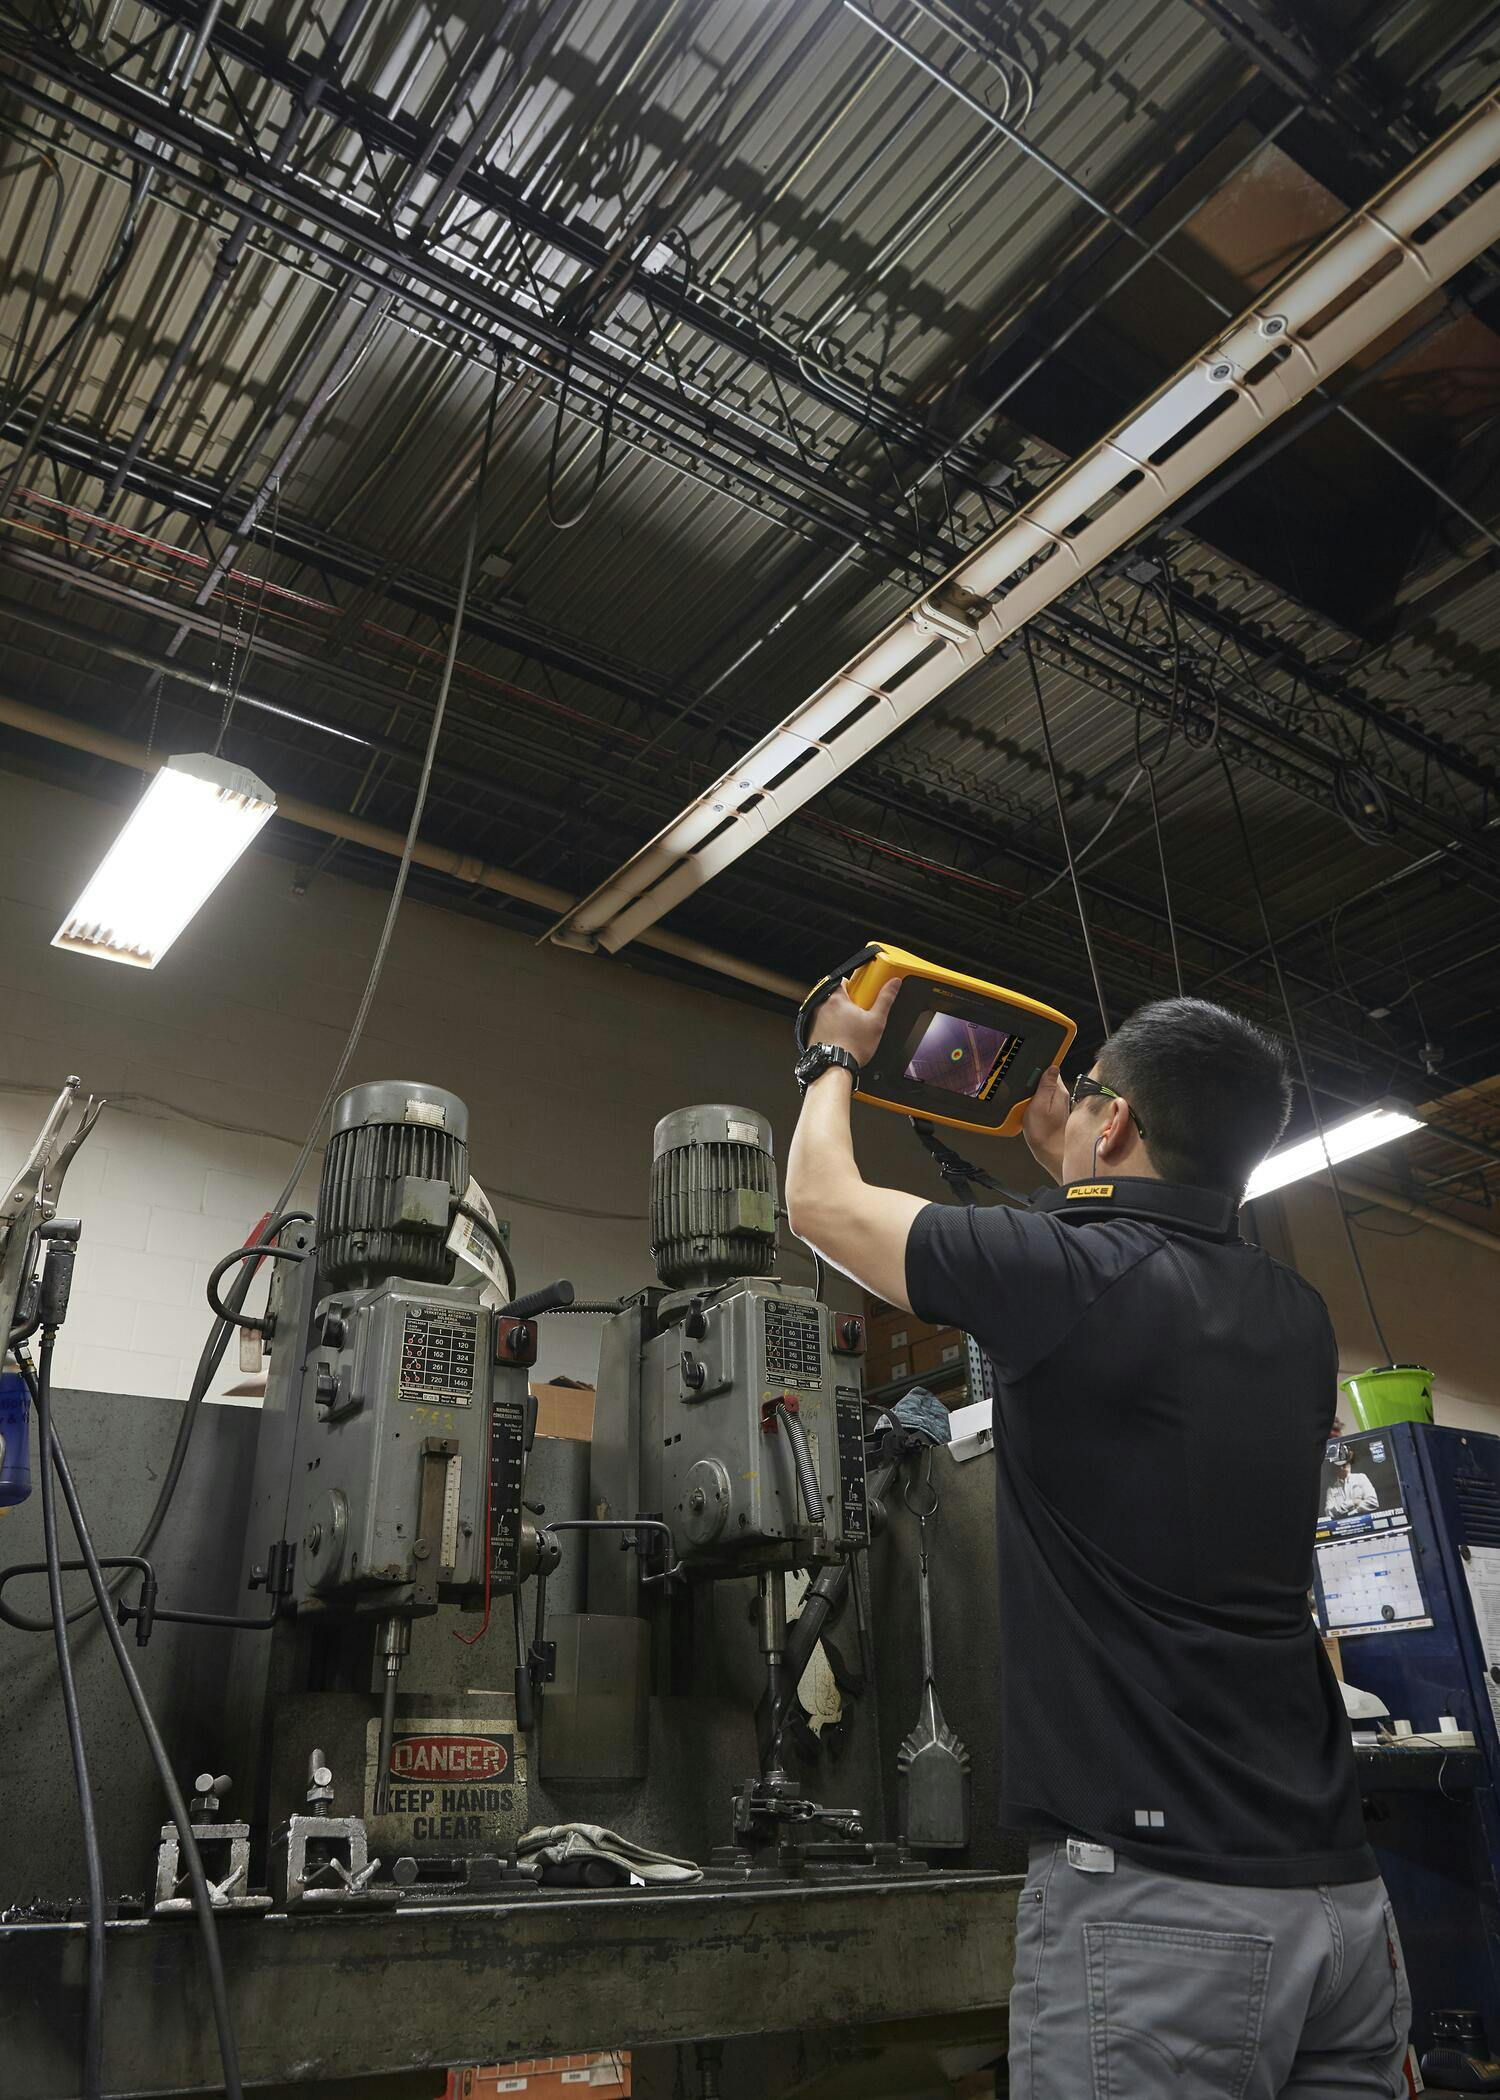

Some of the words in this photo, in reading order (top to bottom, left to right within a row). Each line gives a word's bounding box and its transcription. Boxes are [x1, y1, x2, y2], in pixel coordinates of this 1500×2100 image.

[394, 1745, 500, 1772] DANGER
[442, 1790, 513, 1812] HANDS
[413, 1817, 481, 1840] CLEAR
